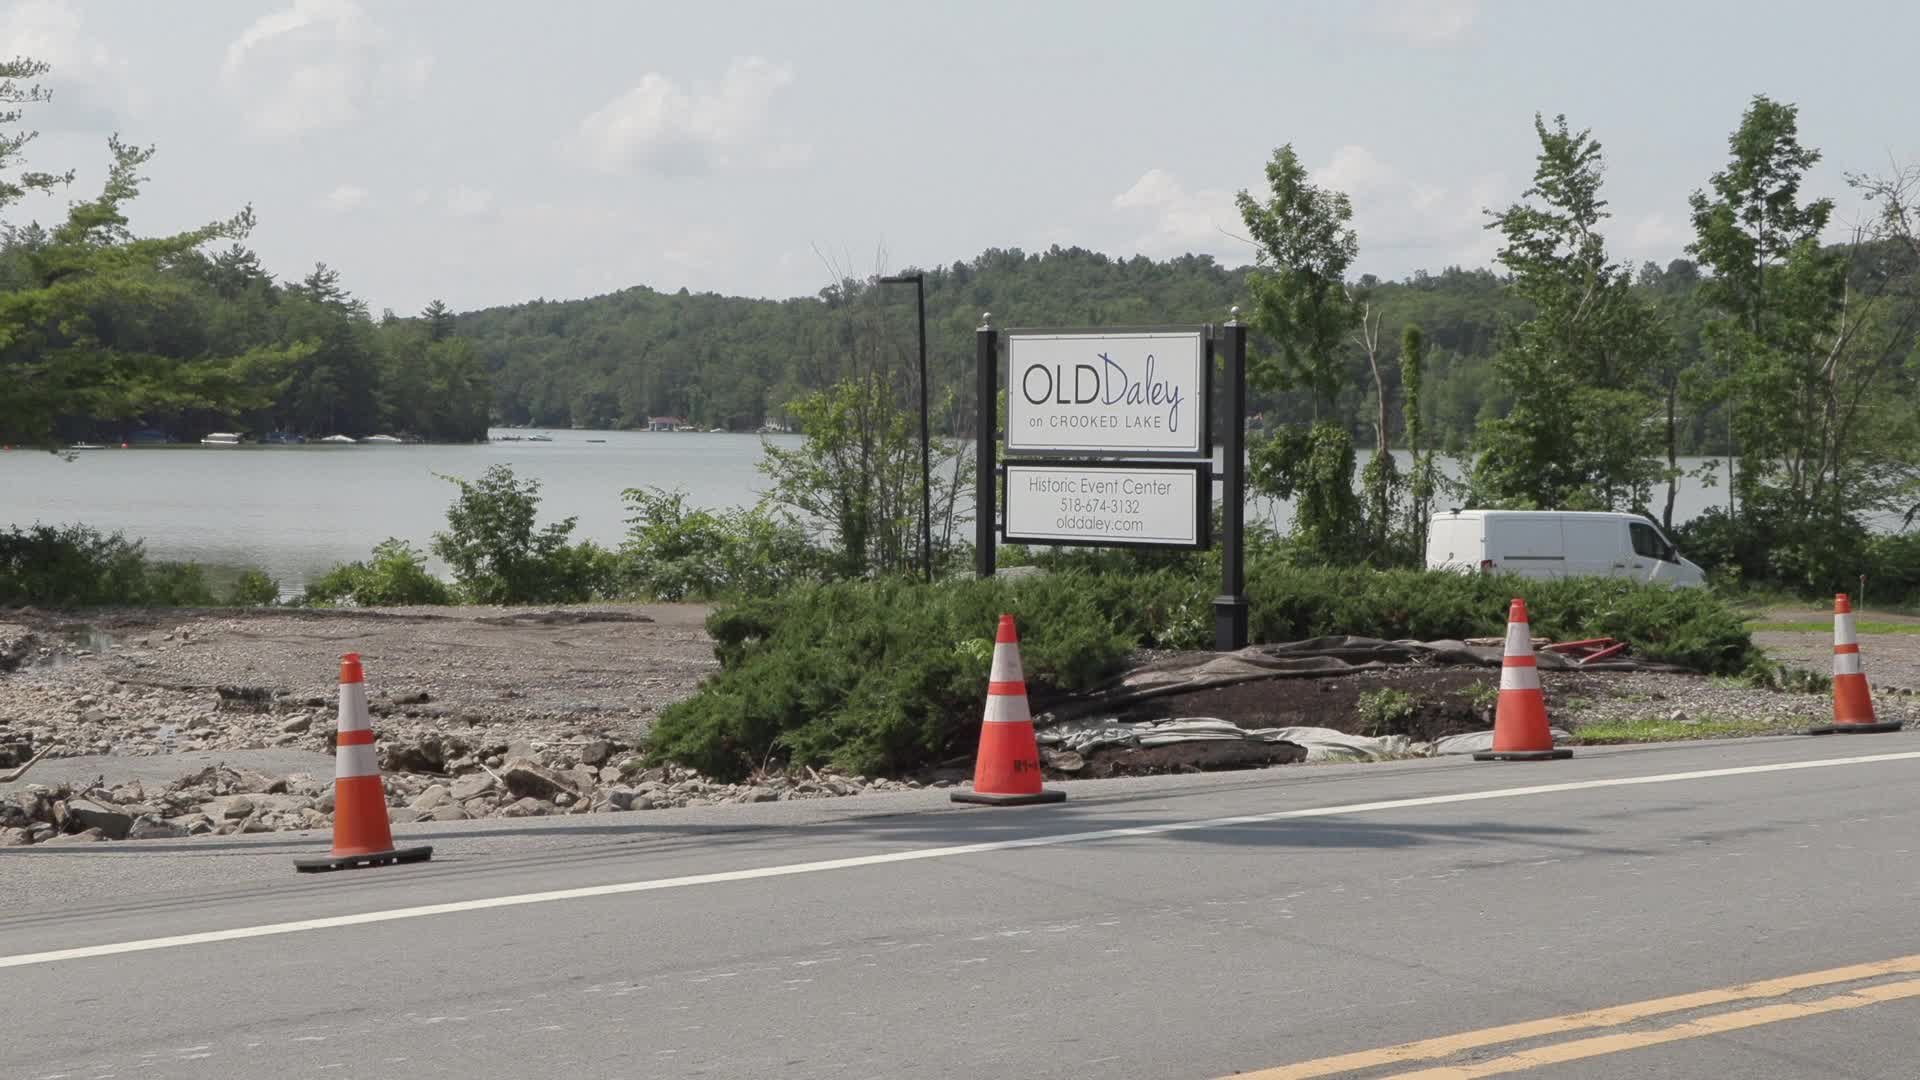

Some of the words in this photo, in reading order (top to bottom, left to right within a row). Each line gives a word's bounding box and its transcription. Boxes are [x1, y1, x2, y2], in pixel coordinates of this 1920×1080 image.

[1022, 364, 1100, 405] OLD
[1097, 352, 1184, 432] Daley
[1029, 418, 1043, 428] on
[1050, 415, 1118, 428] CROOKED
[1125, 415, 1161, 428] LAKE
[1029, 477, 1076, 493] Historic
[1081, 478, 1118, 494] Event
[1123, 479, 1172, 496] Center
[1060, 499, 1140, 514] 518-674-3132
[1056, 515, 1144, 533] olddaley.com
